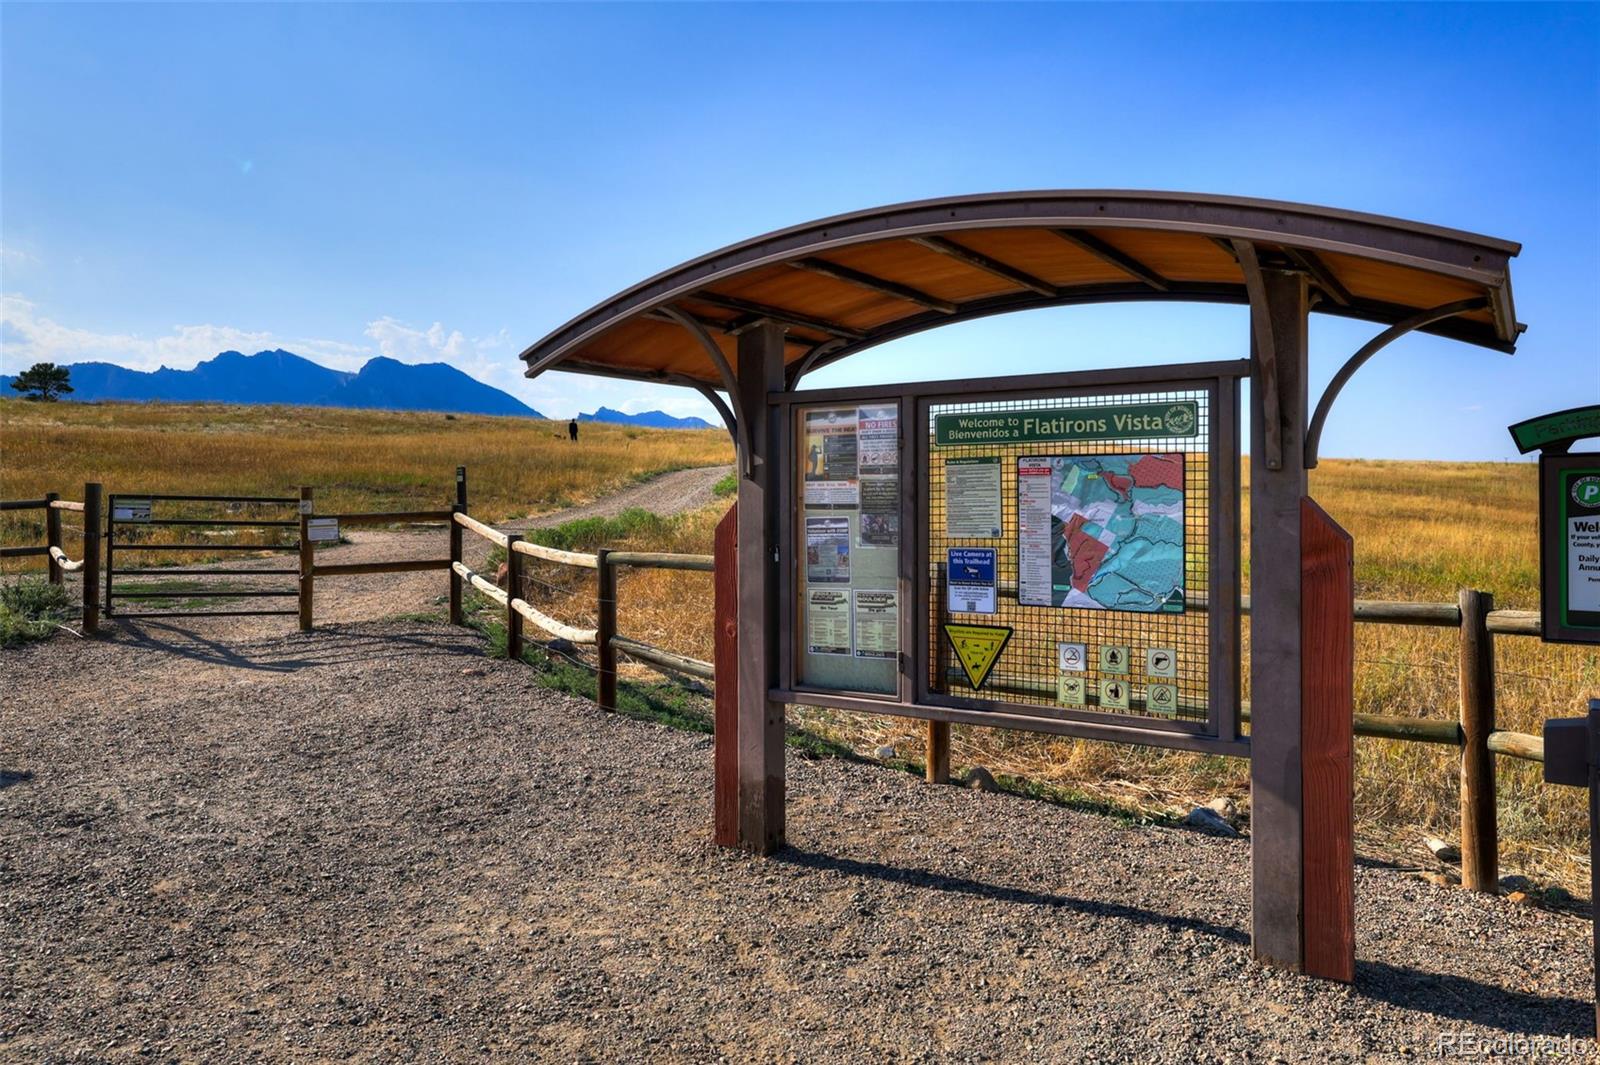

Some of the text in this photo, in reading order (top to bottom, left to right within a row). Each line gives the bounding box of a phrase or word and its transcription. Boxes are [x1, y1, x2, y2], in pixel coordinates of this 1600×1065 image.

[958, 416, 1019, 429] Welcome to
[1023, 413, 1163, 436] Flatirons Vista
[949, 427, 1019, 440] Bienvenidos a
[1584, 485, 1599, 500] P
[1574, 521, 1600, 532] Wel
[1578, 554, 1600, 563] Daily
